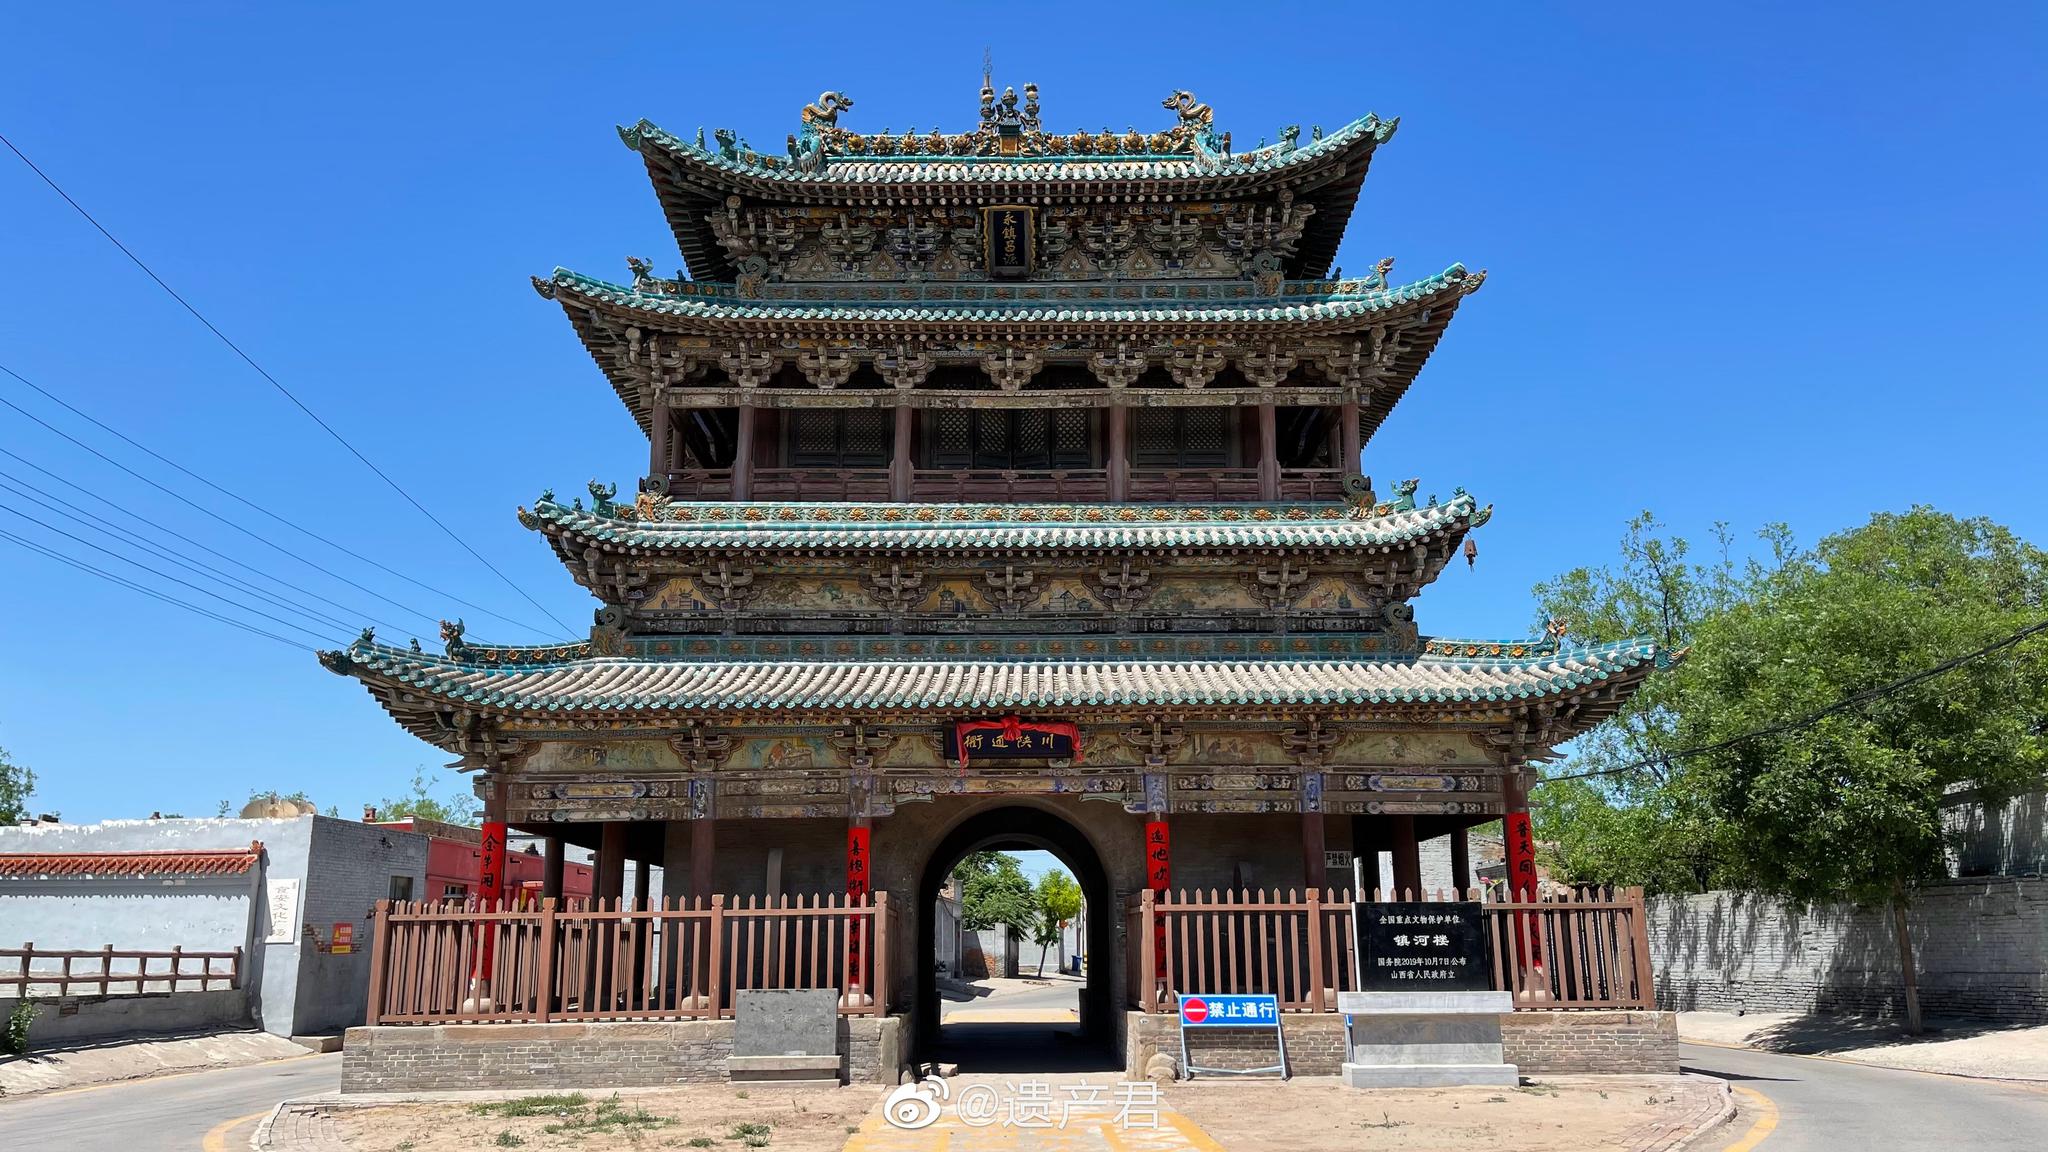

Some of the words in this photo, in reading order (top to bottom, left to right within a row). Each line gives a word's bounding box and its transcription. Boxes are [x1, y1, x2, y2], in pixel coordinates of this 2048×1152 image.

[1379, 915, 1460, 924] 全国重点文物保护单位
[1393, 934, 1449, 946] 镇河楼
[1377, 956, 1467, 967] 国务院2019年10月7日公布
[1391, 970, 1456, 979] 山西省人民政府立
[1208, 1001, 1274, 1018] 禁止通行
